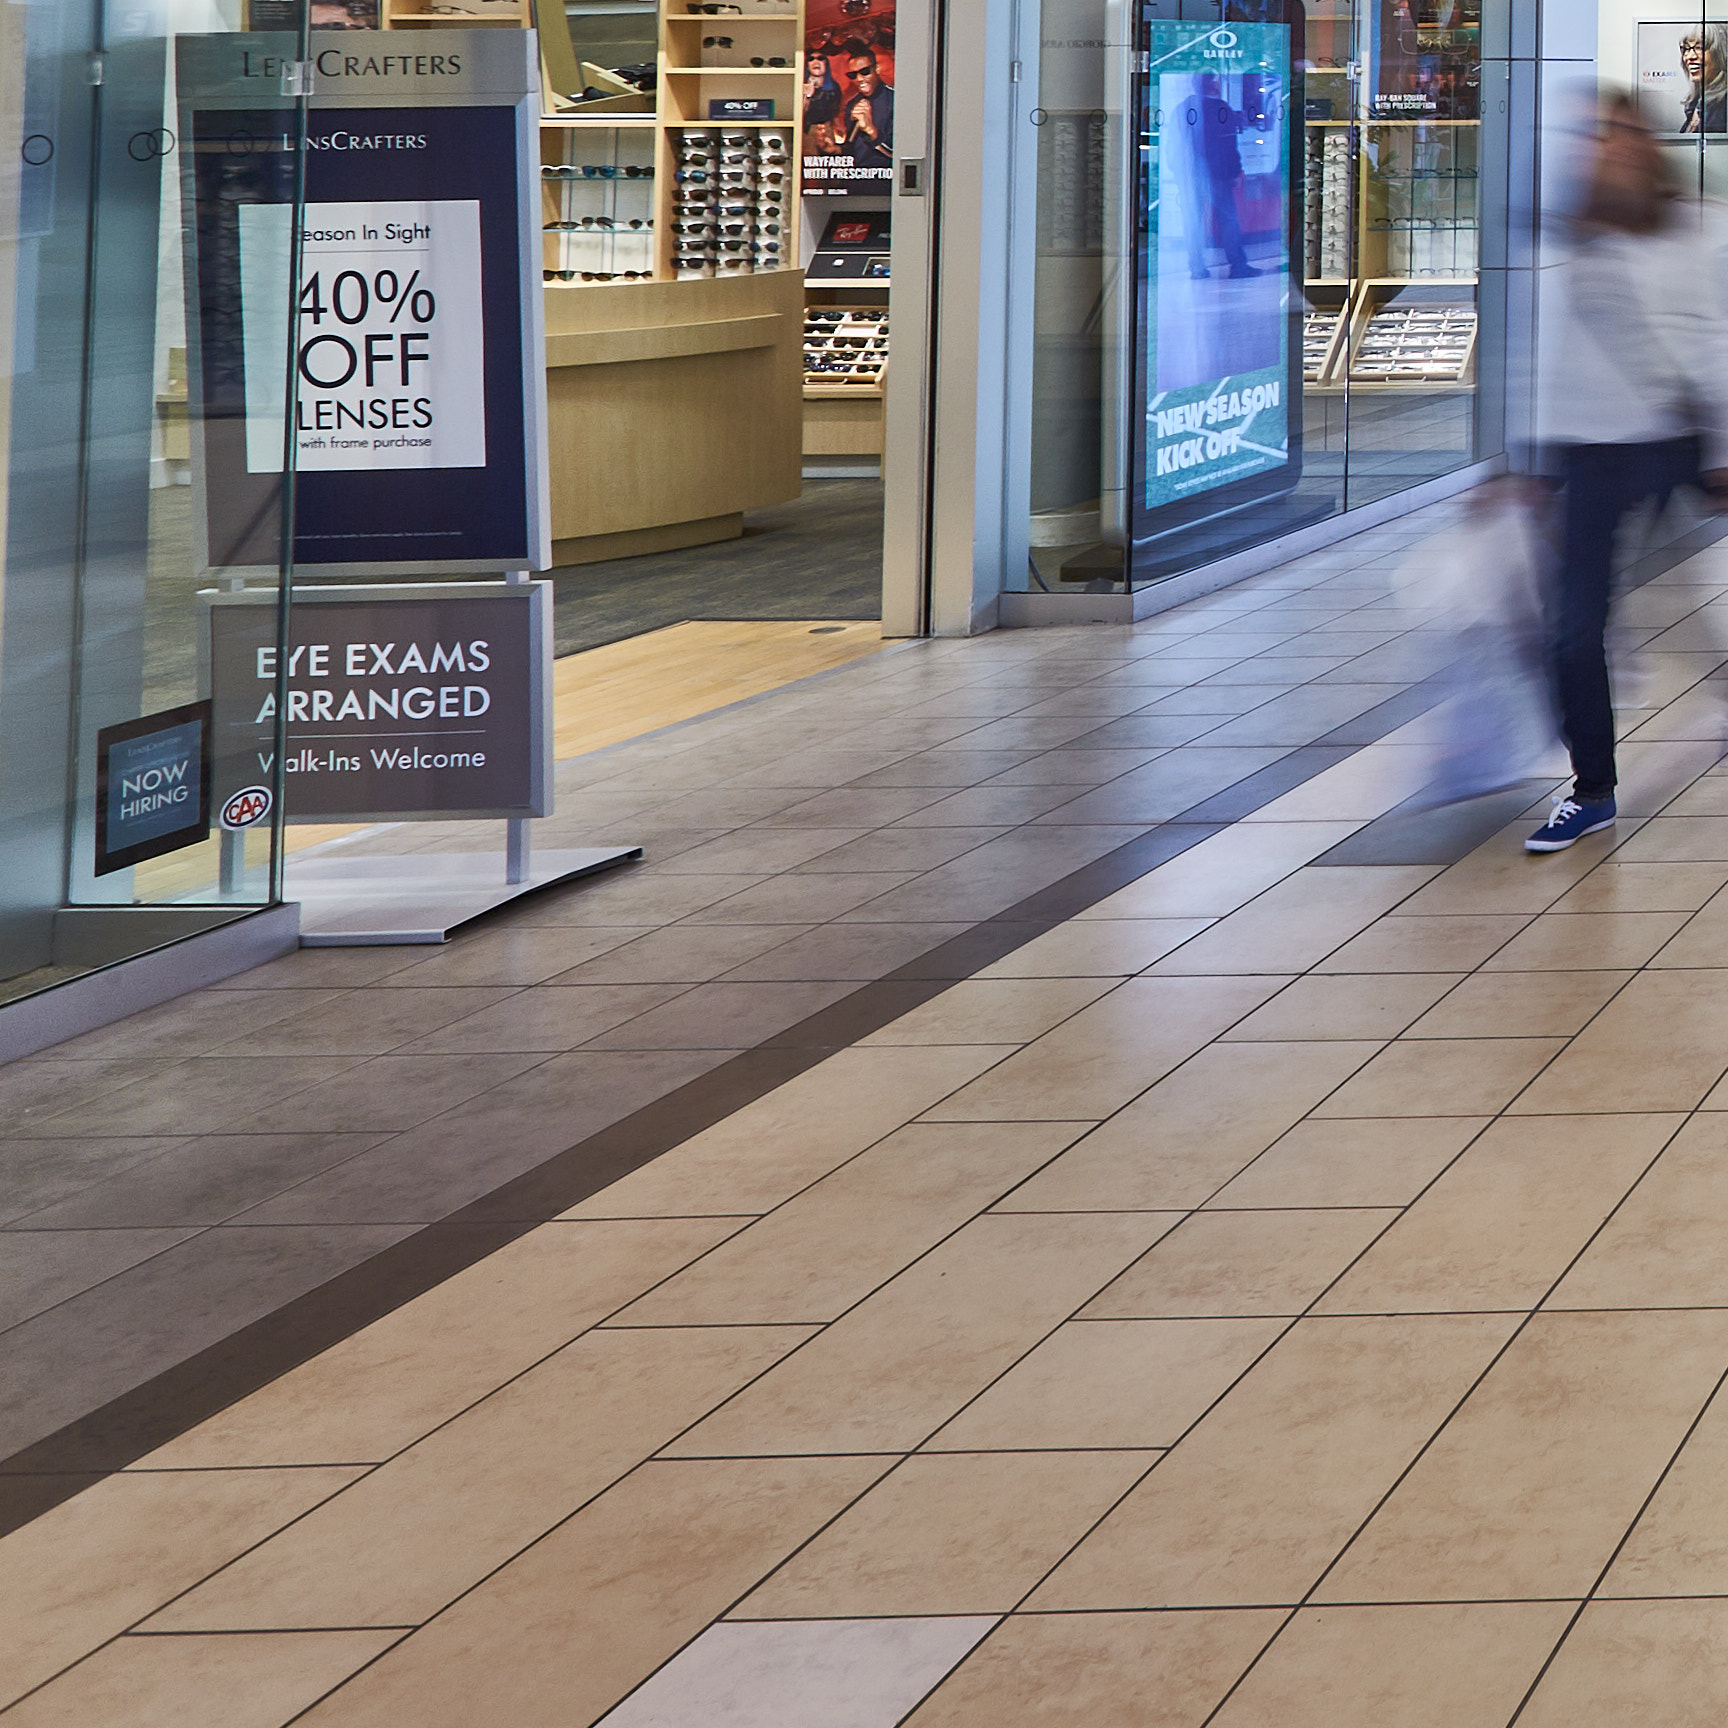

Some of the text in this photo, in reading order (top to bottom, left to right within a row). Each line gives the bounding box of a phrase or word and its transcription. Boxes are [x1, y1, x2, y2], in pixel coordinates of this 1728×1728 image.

[282, 131, 428, 152] LNSCRAFTERS
[803, 156, 854, 168] WAYFARER
[830, 168, 893, 180] PRESCRIPTIO
[302, 222, 432, 244] eason In Sight
[299, 269, 436, 325] 40%
[299, 332, 430, 389] OFF
[298, 397, 434, 431] LENSES
[1156, 380, 1280, 439] NEW SEASON
[299, 434, 433, 451] with frame purchase
[1156, 436, 1205, 477] KICK
[1205, 426, 1242, 460] OFF
[345, 639, 491, 677] EXAMS
[255, 685, 492, 724] ARRANGED
[369, 746, 487, 770] Welcome
[121, 759, 190, 799] NOW
[120, 784, 190, 821] HIRING
[227, 795, 265, 823] CAA
